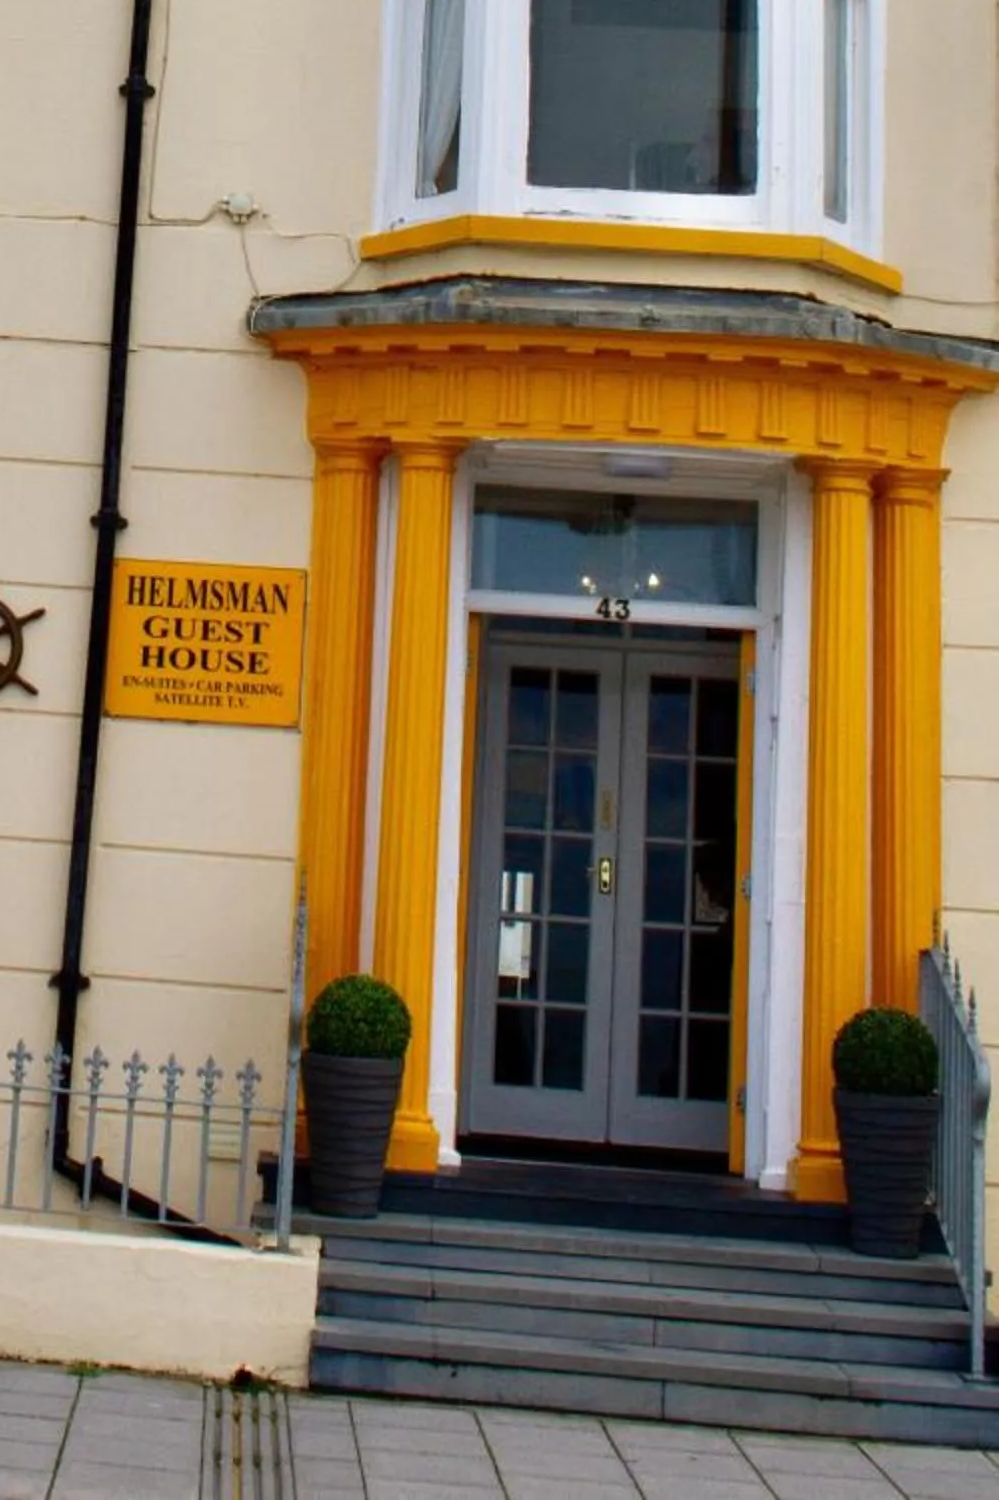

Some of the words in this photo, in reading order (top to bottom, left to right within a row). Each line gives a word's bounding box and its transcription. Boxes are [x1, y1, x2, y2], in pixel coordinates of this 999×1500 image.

[127, 574, 291, 615] HELMSMAN
[595, 596, 631, 620] 43
[142, 614, 271, 646] GUEST
[140, 645, 271, 677] HOUSE
[154, 691, 224, 708] SATELLITE
[195, 680, 223, 694] CAR
[226, 681, 284, 698] PARKING
